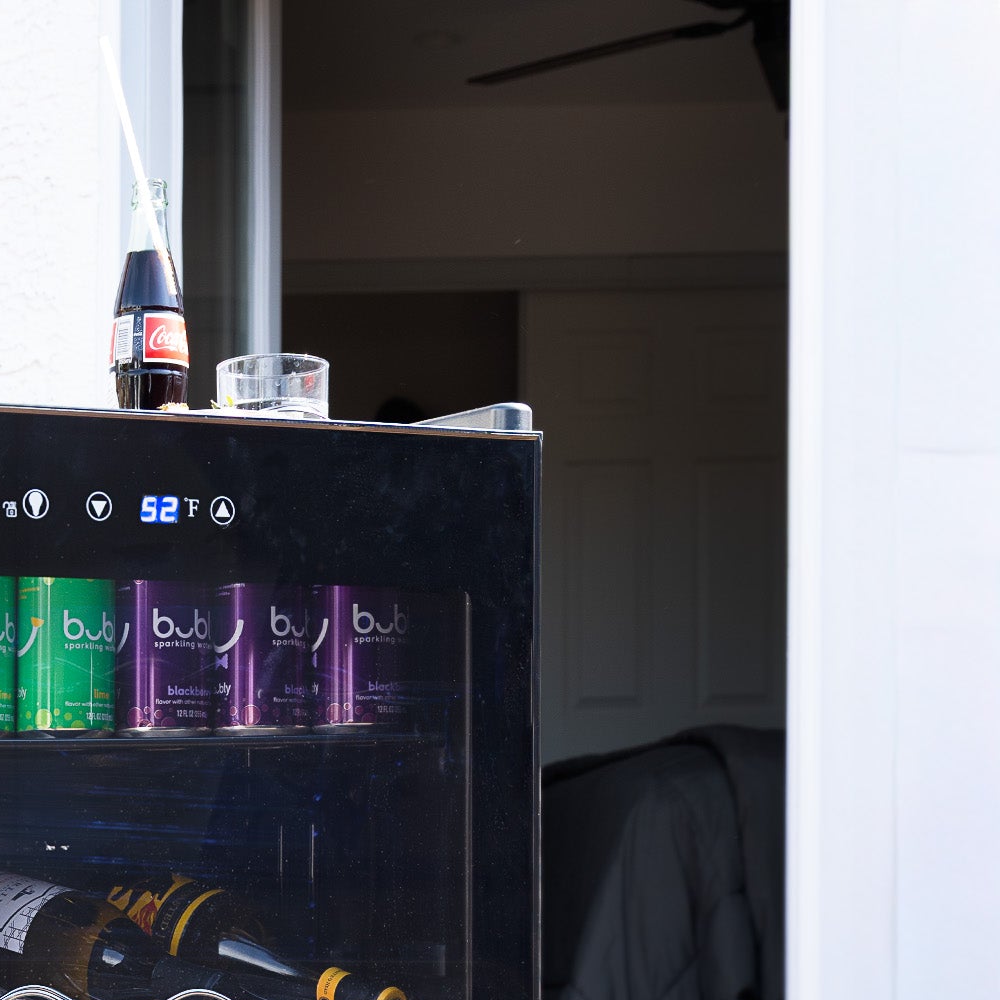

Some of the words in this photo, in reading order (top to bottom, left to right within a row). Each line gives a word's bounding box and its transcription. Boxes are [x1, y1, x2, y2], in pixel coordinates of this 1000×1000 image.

[140, 496, 178, 522] 52
[153, 608, 211, 640] bubl
[353, 603, 408, 635] bub
[64, 641, 104, 653] sparkling
[154, 639, 196, 650] sparkling
[354, 636, 396, 646] sparkling
